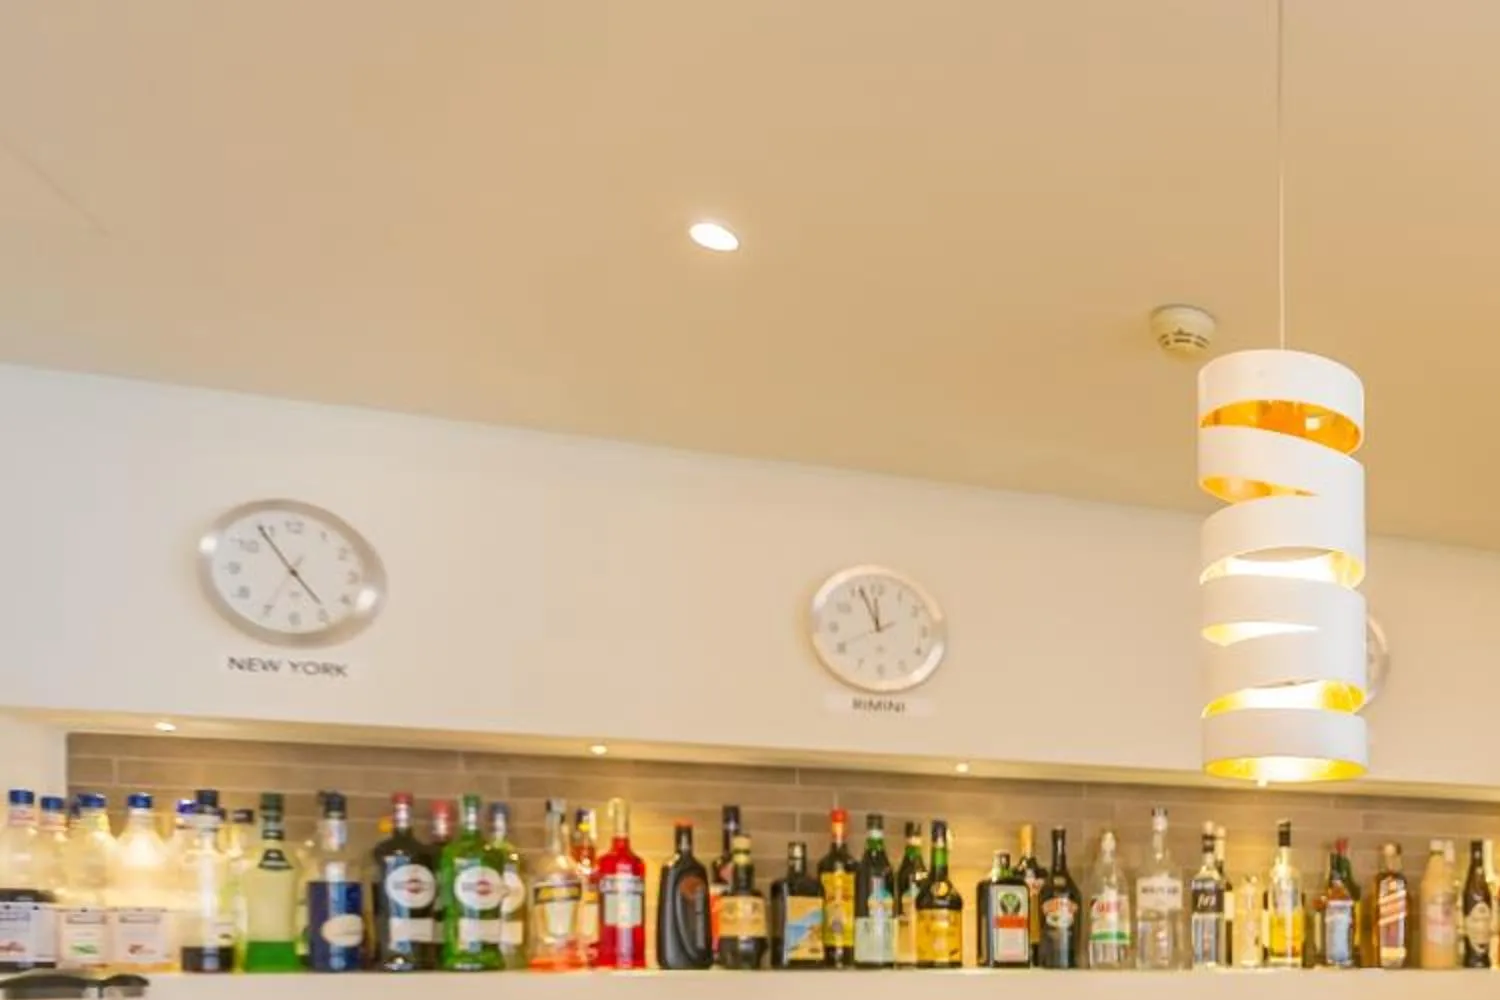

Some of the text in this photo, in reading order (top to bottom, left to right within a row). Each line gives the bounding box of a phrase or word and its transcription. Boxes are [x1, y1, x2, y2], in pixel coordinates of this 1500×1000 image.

[227, 657, 348, 677] NEW YORK
[852, 698, 906, 712] RIMINI
